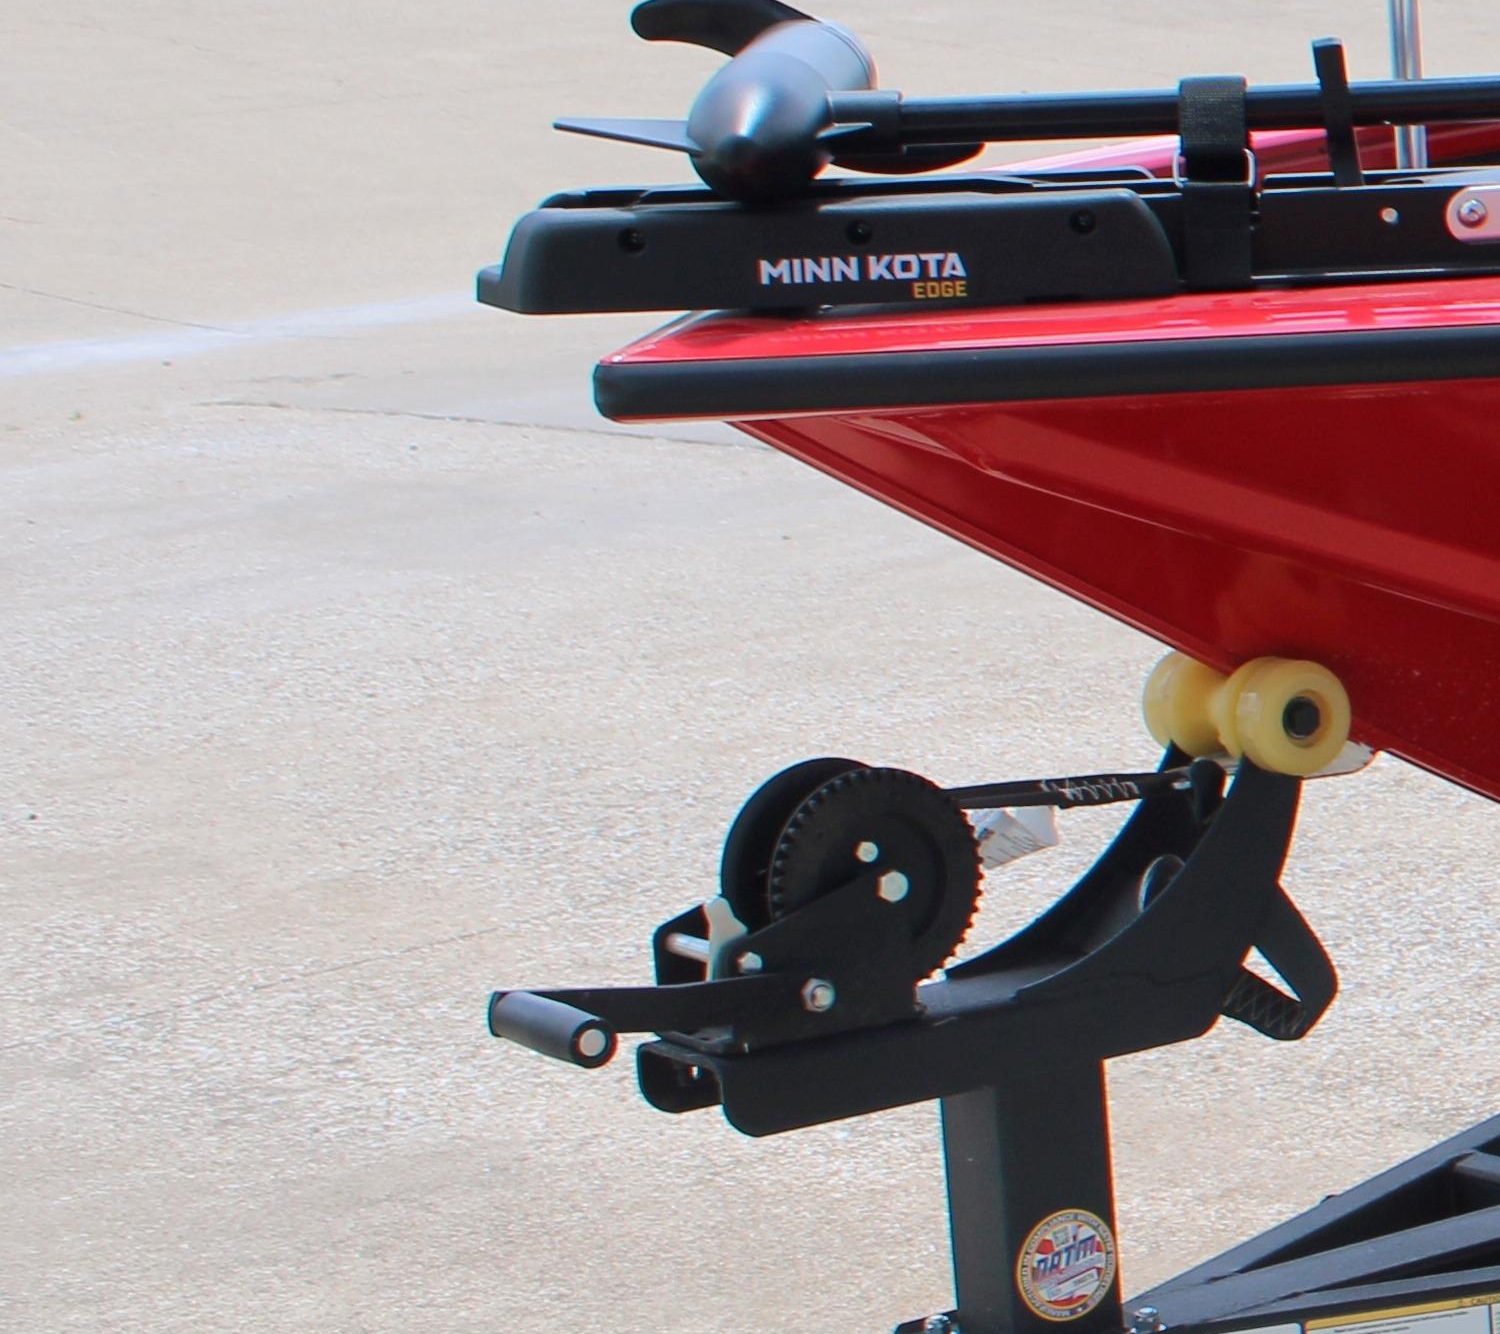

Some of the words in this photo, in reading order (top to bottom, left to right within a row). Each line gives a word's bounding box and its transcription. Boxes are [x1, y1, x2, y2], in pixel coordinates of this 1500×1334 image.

[759, 256, 860, 285] MINN
[867, 252, 967, 280] KOTA
[913, 281, 968, 298] EDGE
